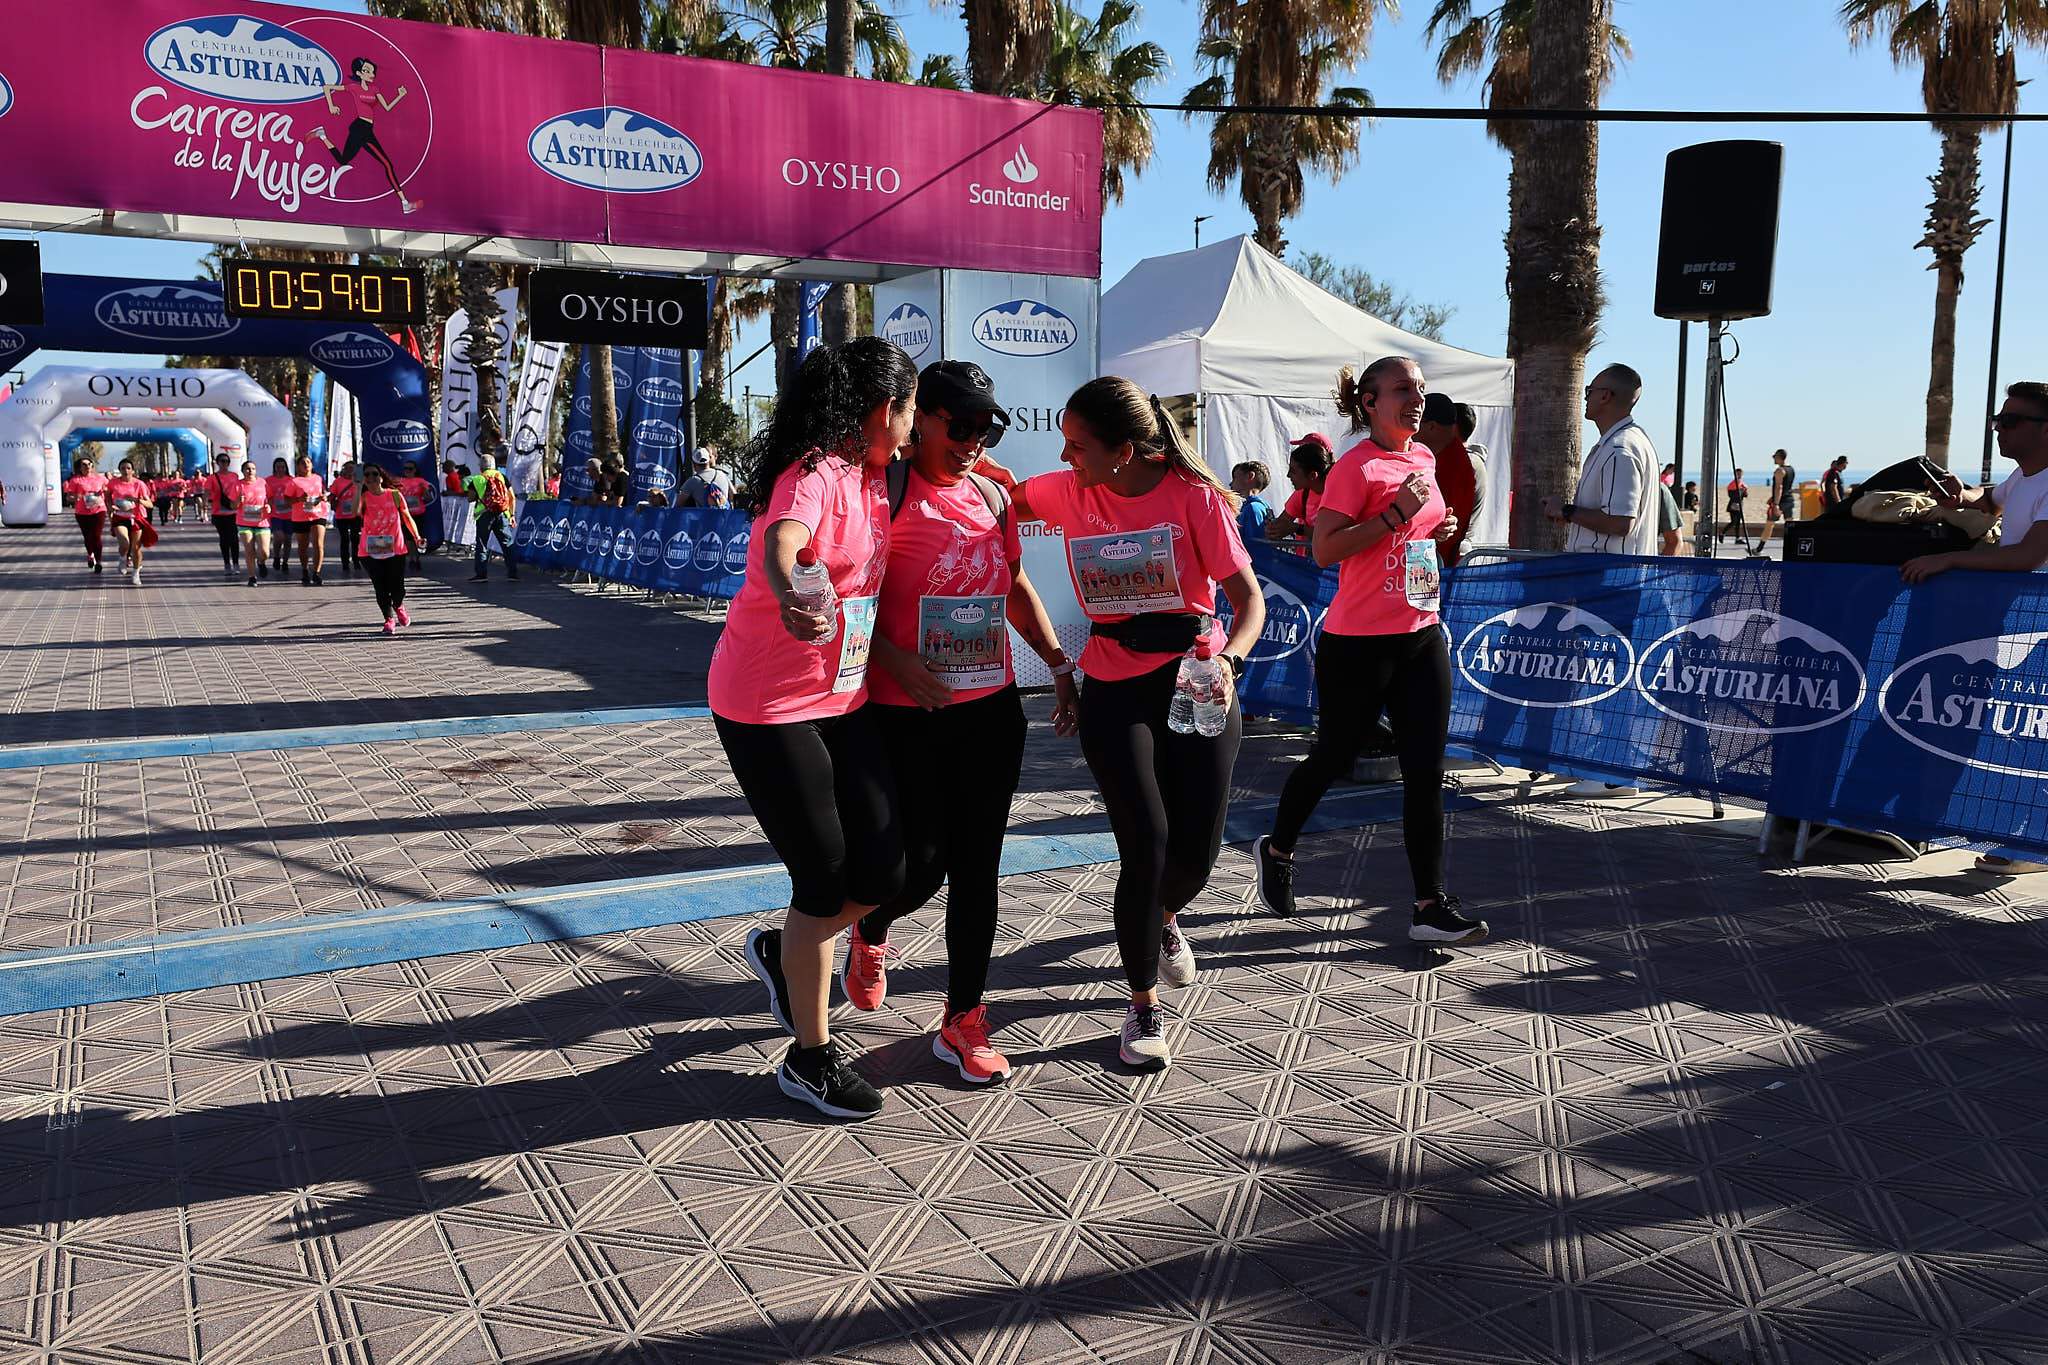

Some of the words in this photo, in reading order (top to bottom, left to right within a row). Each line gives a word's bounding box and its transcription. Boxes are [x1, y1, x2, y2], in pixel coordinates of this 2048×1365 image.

[161, 38, 327, 87] ASTURIANA
[191, 39, 253, 55] CENTRAL
[259, 48, 320, 62] LECHERA
[131, 86, 294, 144] Carrera
[174, 138, 204, 168] de
[211, 141, 233, 172] la
[543, 132, 689, 175] ASTURIANA
[569, 133, 624, 146] CENTRAL
[629, 138, 684, 151] LECHERA
[231, 140, 352, 213] Mujer
[781, 158, 901, 194] OYSHO
[969, 182, 1070, 212] Santander
[237, 268, 411, 313] 00:59:07
[107, 300, 231, 328] ASTURIANA
[560, 294, 684, 326] OYSHO
[980, 319, 1069, 344] ASTURIANA
[317, 345, 389, 360] ASTURIANA
[88, 374, 205, 398] OYSHO
[514, 341, 559, 456] OYSH
[1500, 634, 1552, 648] CENTRAL
[1557, 639, 1617, 652] LECHERA
[1467, 634, 1616, 686] ASTURIANA
[1688, 648, 1759, 663] CENTRAL
[1763, 652, 1841, 673] LECHERA
[1647, 648, 1841, 711] ASTURIANA
